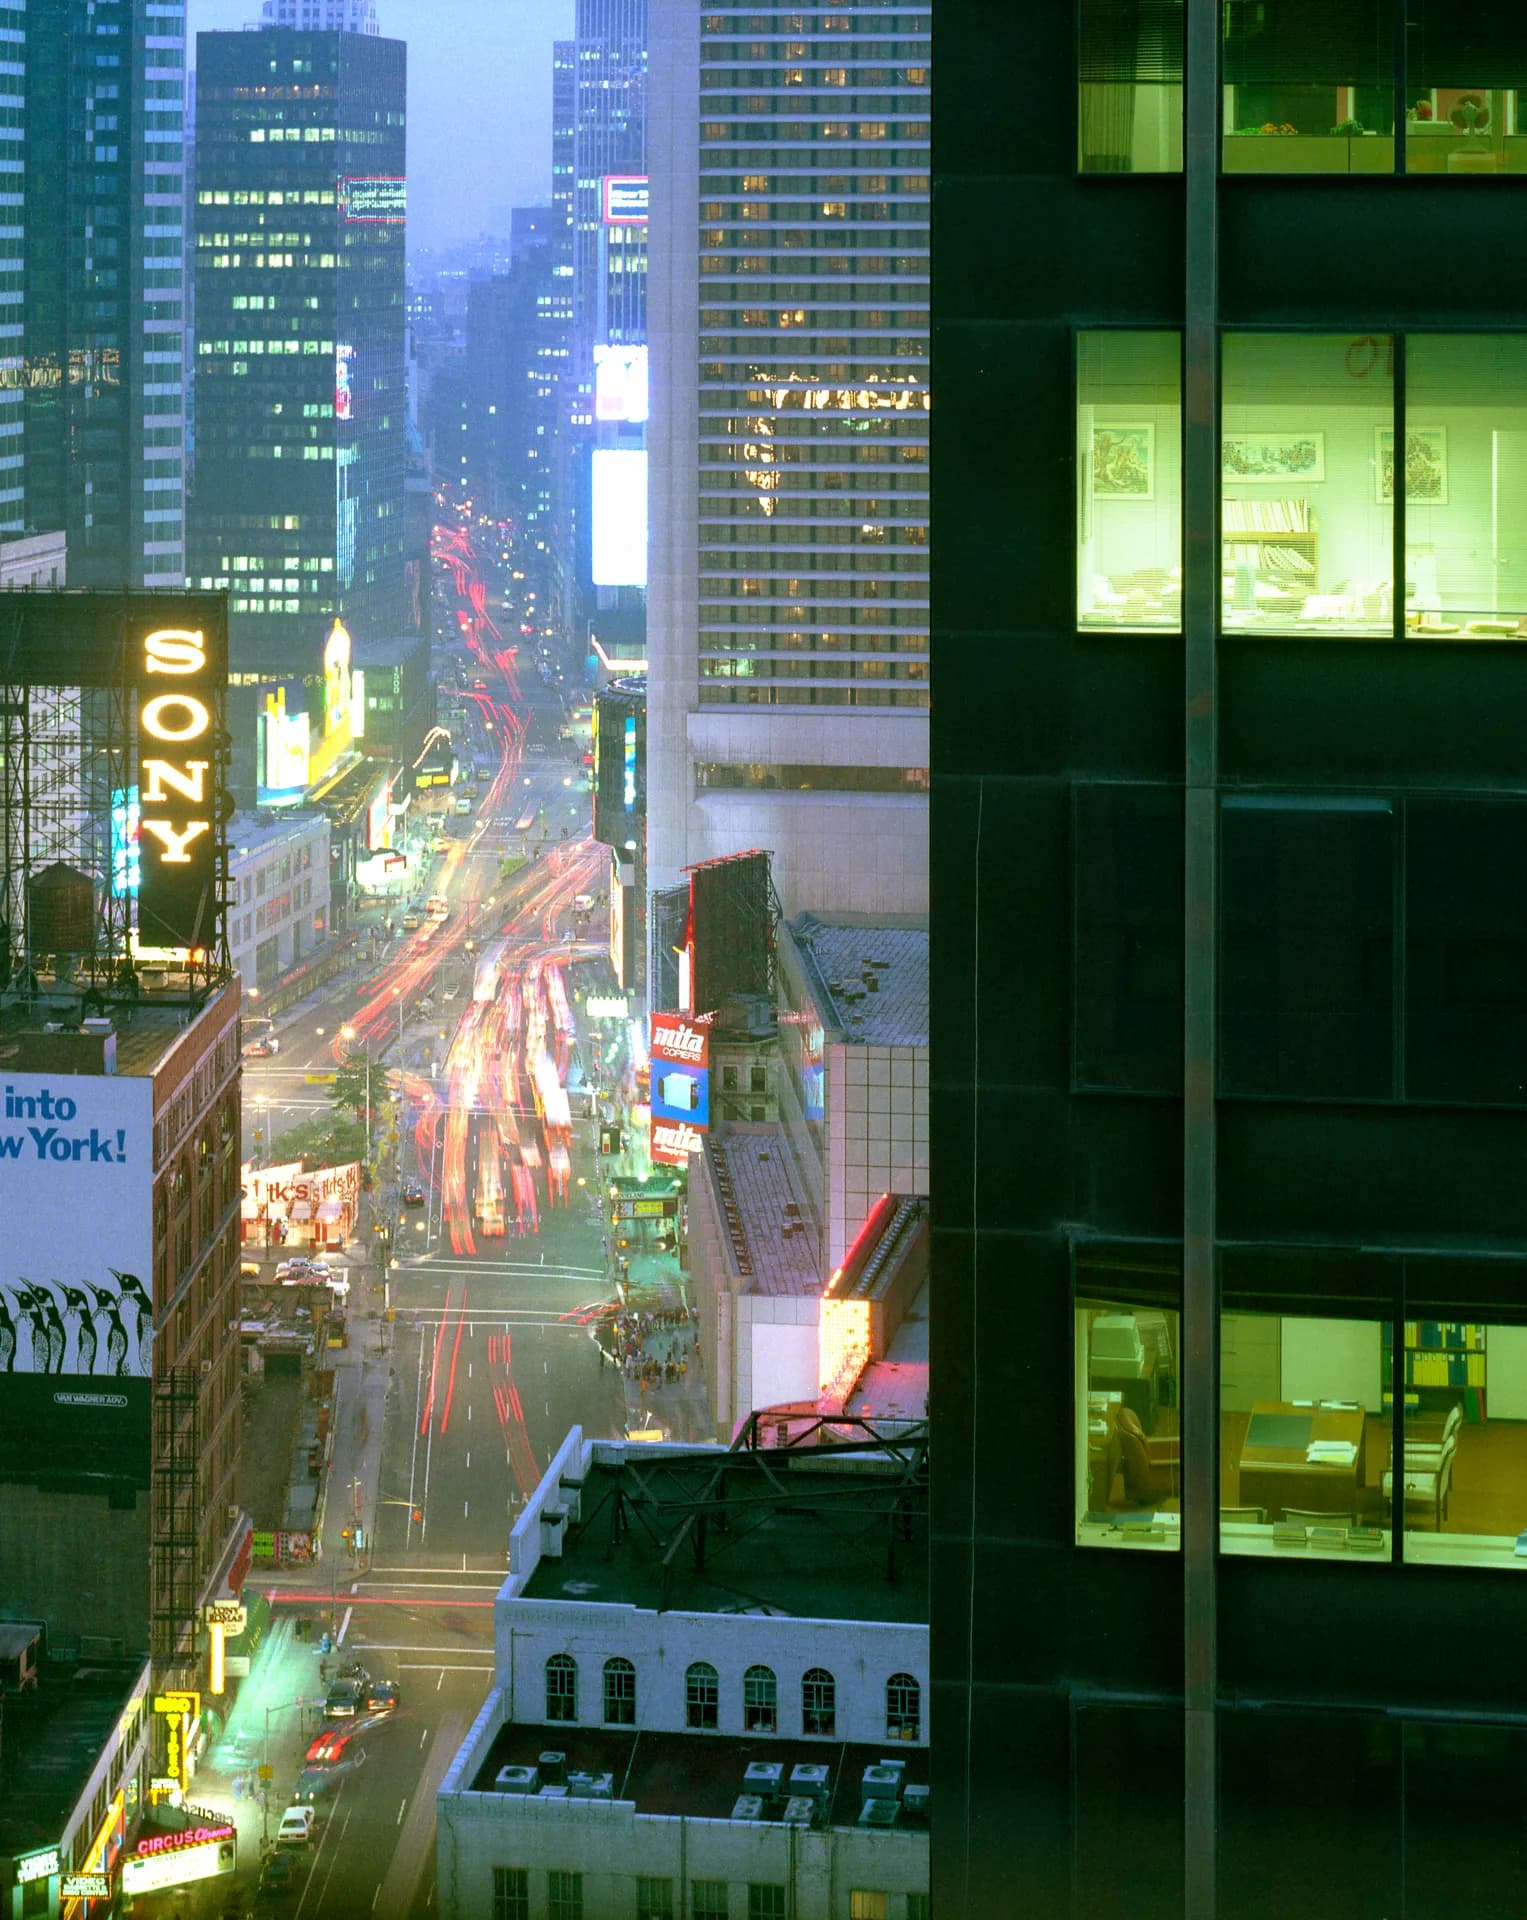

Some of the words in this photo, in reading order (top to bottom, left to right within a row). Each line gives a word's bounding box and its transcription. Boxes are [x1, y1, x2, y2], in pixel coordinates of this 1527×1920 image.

[143, 629, 209, 862] SONY
[653, 1023, 705, 1053] mita
[662, 1047, 702, 1062] COPIERS
[5, 1085, 77, 1121] into
[27, 1126, 126, 1164] York!
[137, 1829, 194, 1854] CIRCUS
[66, 1877, 106, 1885] VIDEO
